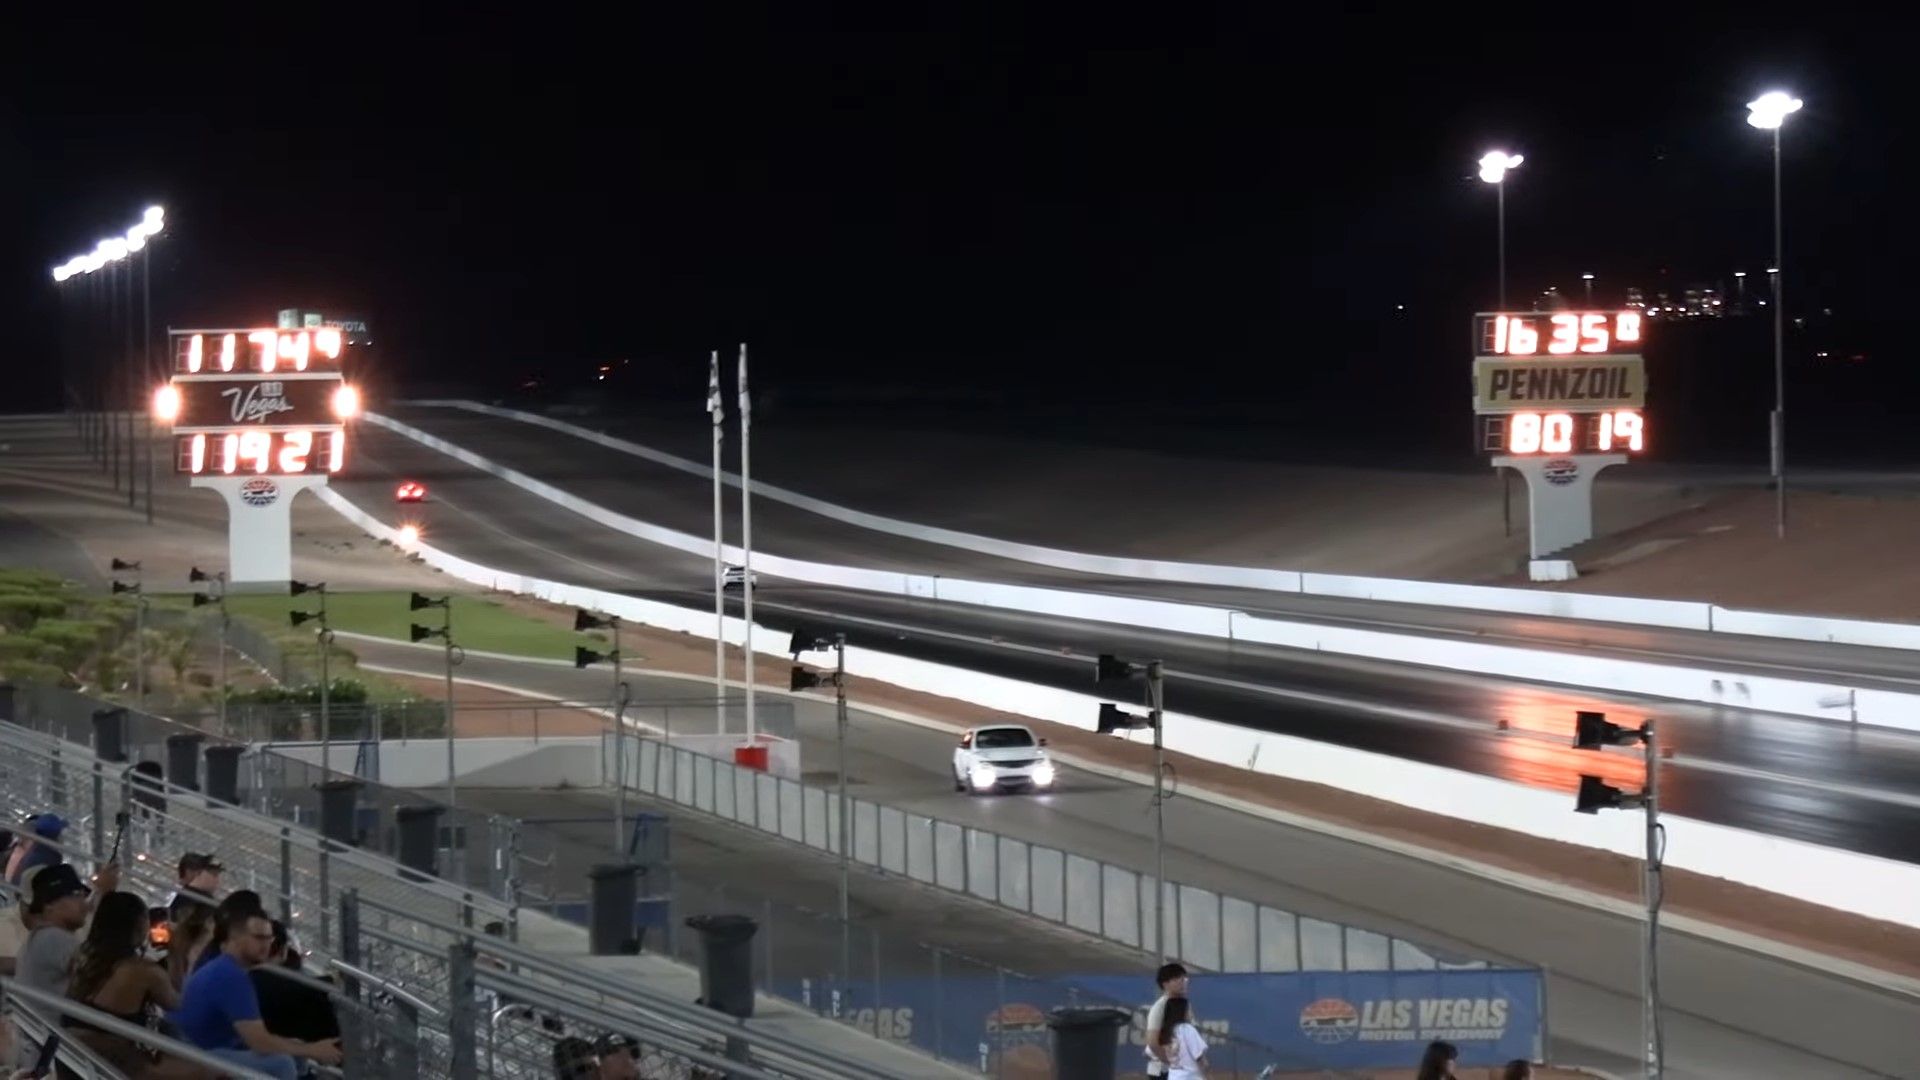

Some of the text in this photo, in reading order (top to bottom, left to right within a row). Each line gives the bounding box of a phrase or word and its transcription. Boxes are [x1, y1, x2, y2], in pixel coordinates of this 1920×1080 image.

[1490, 366, 1633, 401] PENNZOIL
[221, 384, 295, 424] Vegas
[1360, 998, 1509, 1029] LAS VEGAS
